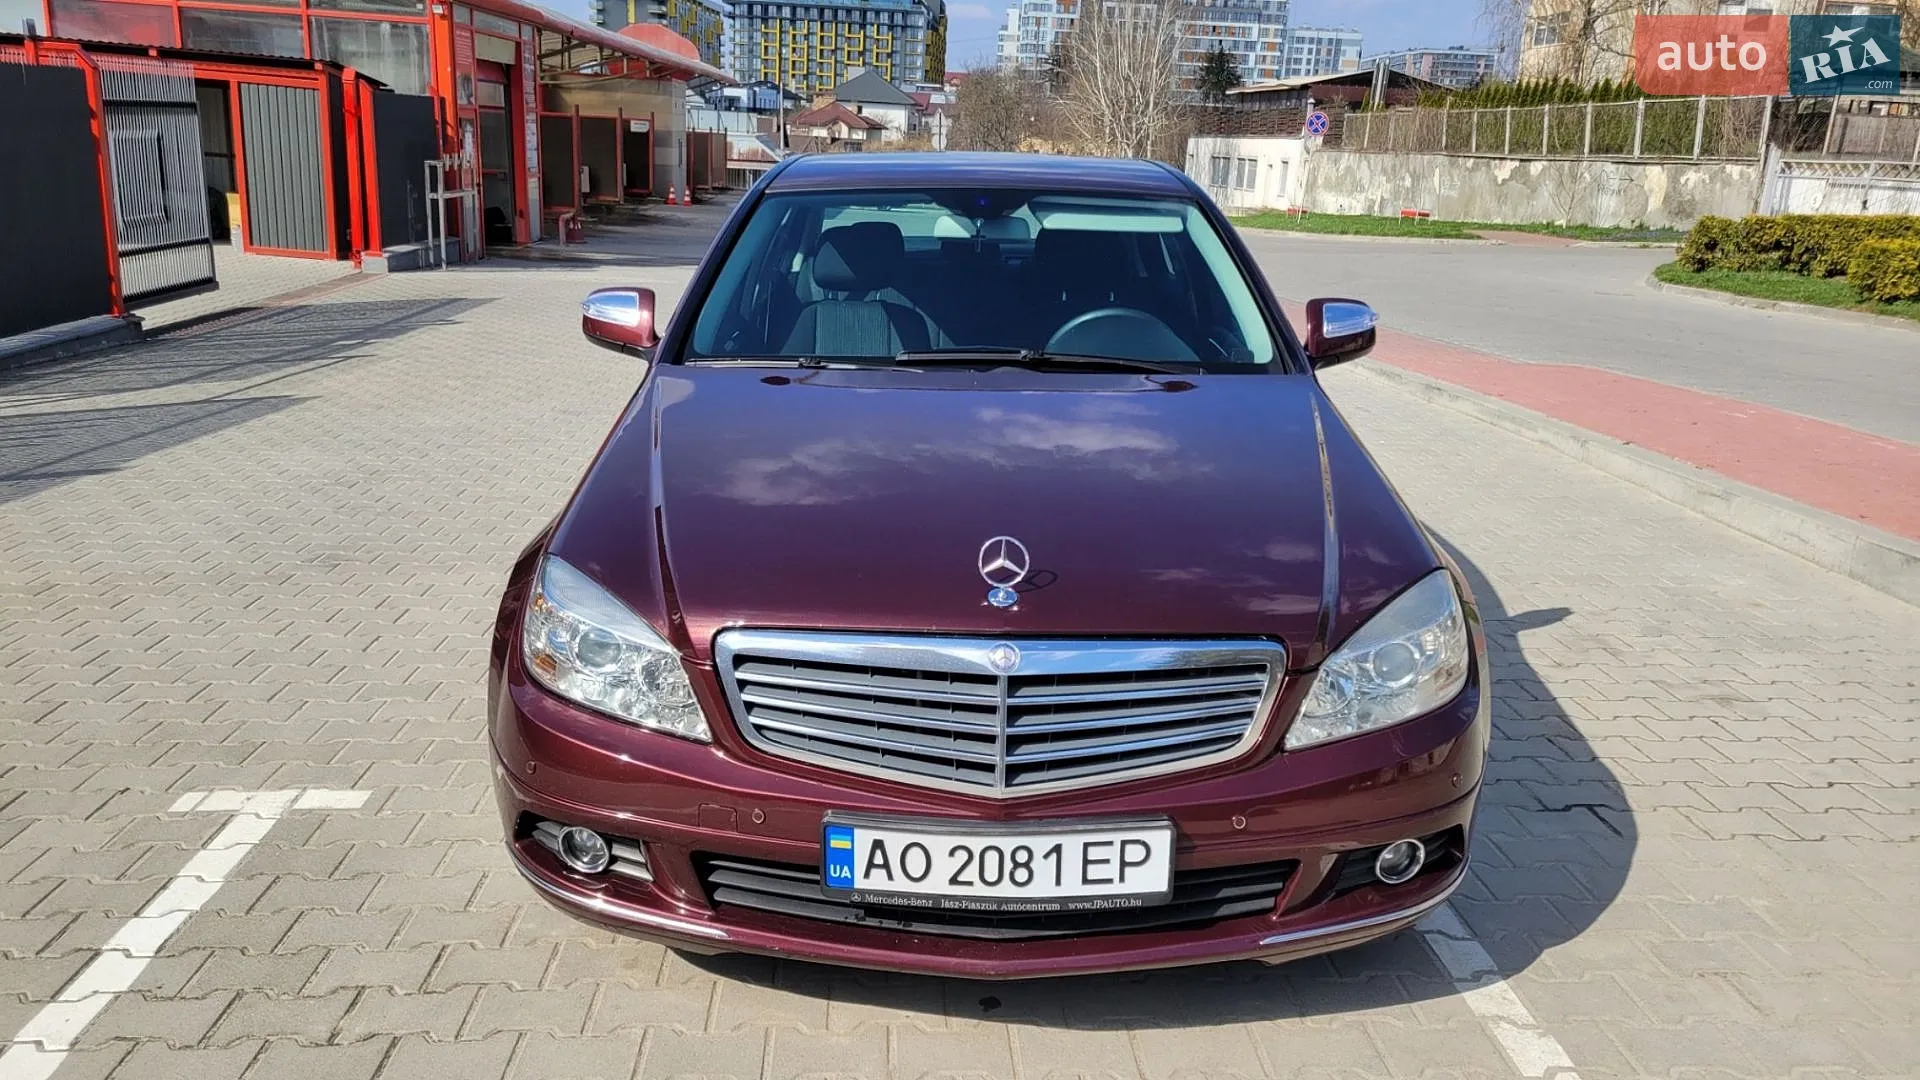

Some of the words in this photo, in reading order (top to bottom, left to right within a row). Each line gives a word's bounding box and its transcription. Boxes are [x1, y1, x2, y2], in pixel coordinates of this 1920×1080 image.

[862, 838, 932, 883] AO
[948, 843, 1062, 888] 2081
[1081, 839, 1151, 885] EP
[829, 864, 851, 879] UA
[865, 893, 933, 907] Mercedes-Benz
